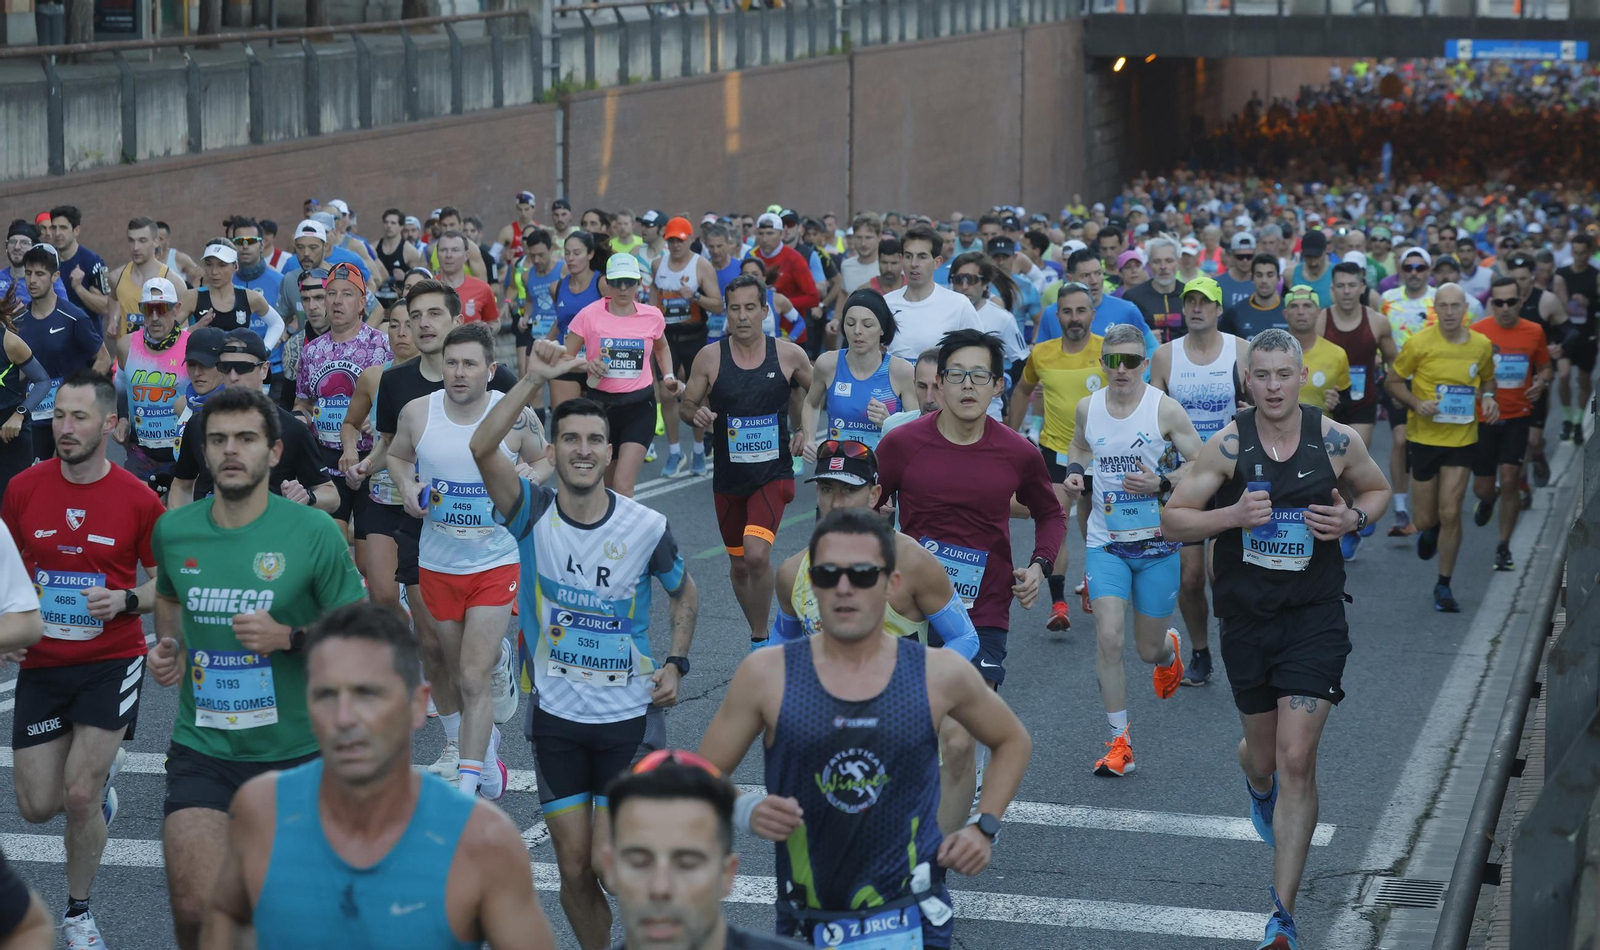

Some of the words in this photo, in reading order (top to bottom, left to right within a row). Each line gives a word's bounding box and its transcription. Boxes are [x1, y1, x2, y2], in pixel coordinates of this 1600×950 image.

[609, 359, 637, 369] KIENER
[310, 361, 336, 389] NOTHING
[337, 361, 353, 370] CAN
[133, 385, 176, 402] STOP
[1176, 382, 1231, 394] RUNNERS
[146, 408, 175, 416] ZURICH
[328, 412, 342, 420] 4810
[316, 421, 342, 432] PABLO
[745, 417, 773, 427] ZURICH
[847, 421, 878, 431] ZURICH
[164, 428, 176, 438] NS
[746, 432, 762, 440] 6767
[735, 440, 772, 452] CHESCO
[1100, 453, 1142, 466] MARATÓN
[1100, 464, 1111, 473] DE
[1110, 463, 1140, 473] SEVILL
[452, 485, 488, 495] ZURICH
[452, 502, 472, 511] 4459
[1121, 507, 1139, 516] 7906
[442, 512, 481, 526] JASON
[1250, 538, 1305, 556] BOWZER
[942, 546, 980, 563] ZURICH
[54, 574, 96, 586] ZURICH
[54, 595, 76, 606] 4685
[186, 586, 275, 614] SIMECO
[193, 615, 233, 627] running
[578, 616, 622, 631] ZURICH
[577, 636, 600, 650] 5351
[212, 654, 260, 667] ZURICH
[549, 648, 579, 665] ALEX
[581, 654, 628, 670] MARTIN
[215, 678, 240, 690] 5193
[195, 696, 231, 712] CARLOS
[233, 695, 275, 711] GOMES
[26, 716, 63, 737] SILVERE
